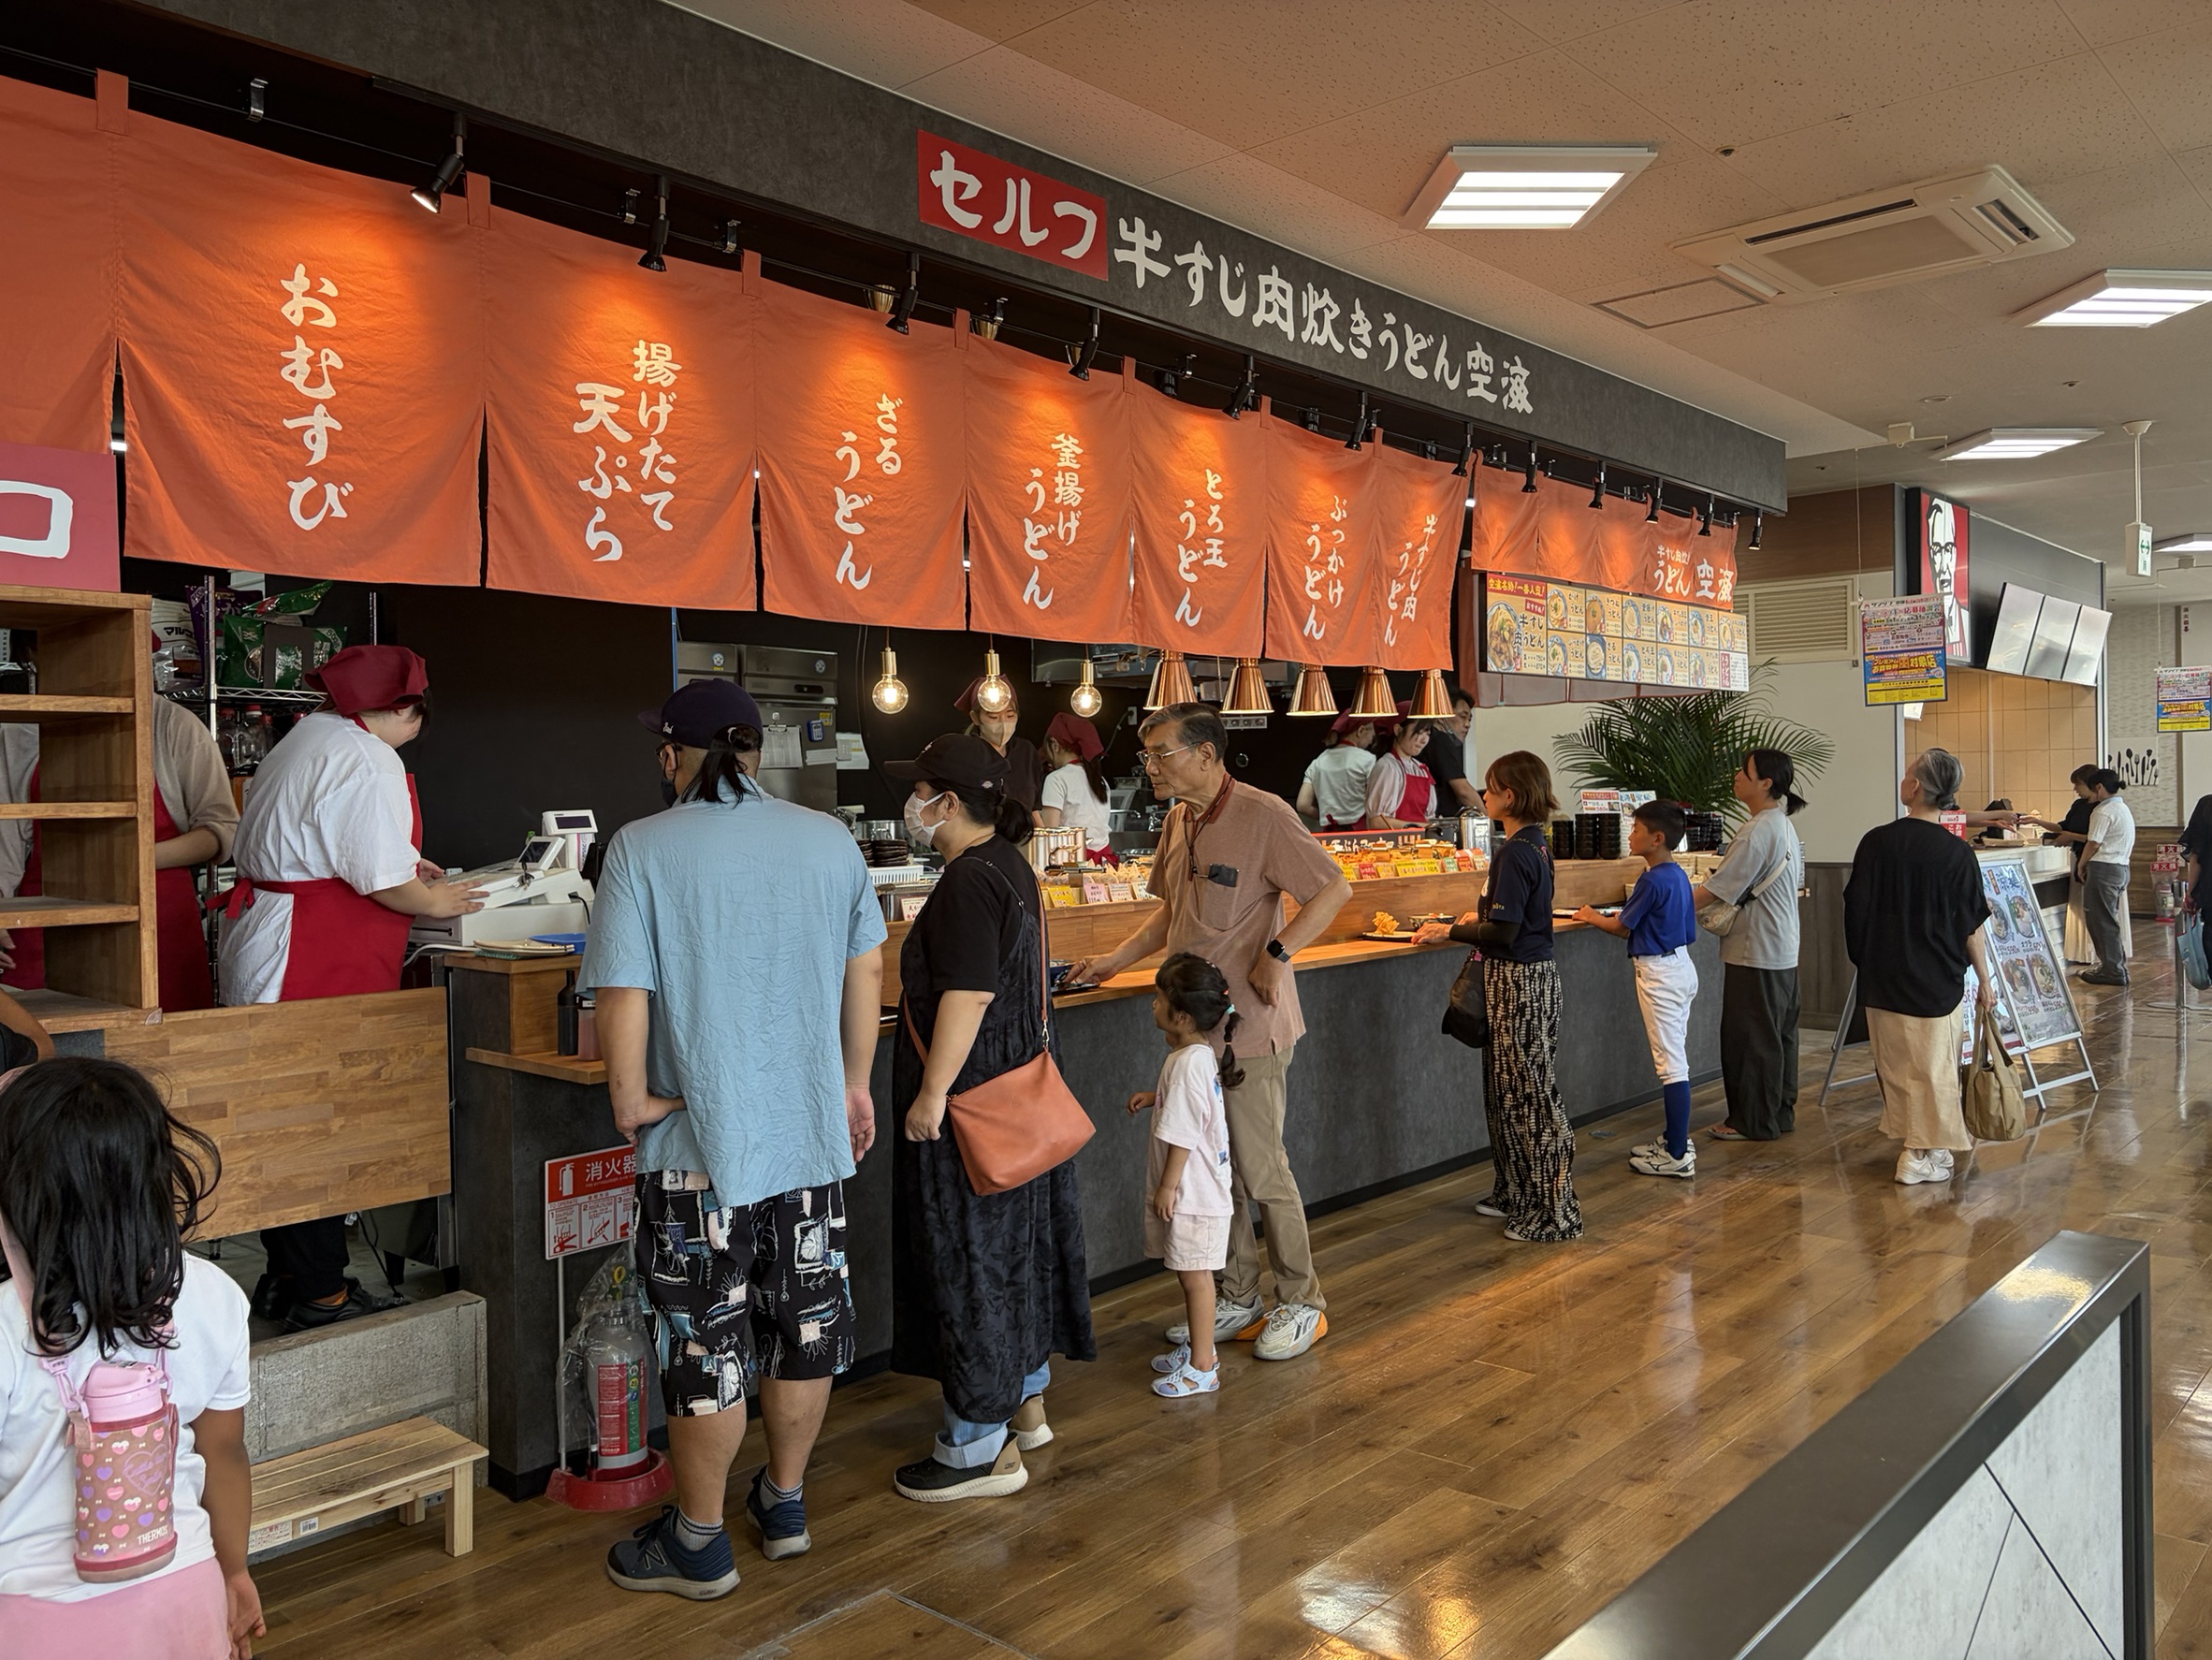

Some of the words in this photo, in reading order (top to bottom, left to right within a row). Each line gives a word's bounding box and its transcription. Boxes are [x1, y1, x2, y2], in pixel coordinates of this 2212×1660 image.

[930, 150, 1098, 259] セルフ
[281, 263, 355, 531] おむすび
[633, 339, 682, 531] 揚げたて
[875, 393, 903, 474] ざる
[573, 383, 633, 561] 天ぷら
[834, 430, 873, 590] うどん
[1051, 433, 1085, 546] 釜揚げ
[1203, 468, 1228, 569] とろ玉
[1023, 468, 1055, 610] うどん
[1175, 499, 1203, 627] うどん
[1303, 523, 1326, 640] うどん
[1327, 495, 1347, 608] ぶっかけ
[1401, 514, 1438, 622] 牛すじ肉
[1653, 560, 1691, 597] うどん
[1384, 542, 1412, 648] うどん
[558, 1199, 578, 1208] OPERATE
[586, 1154, 636, 1182] 消火器
[137, 1525, 168, 1545] THERMOS
